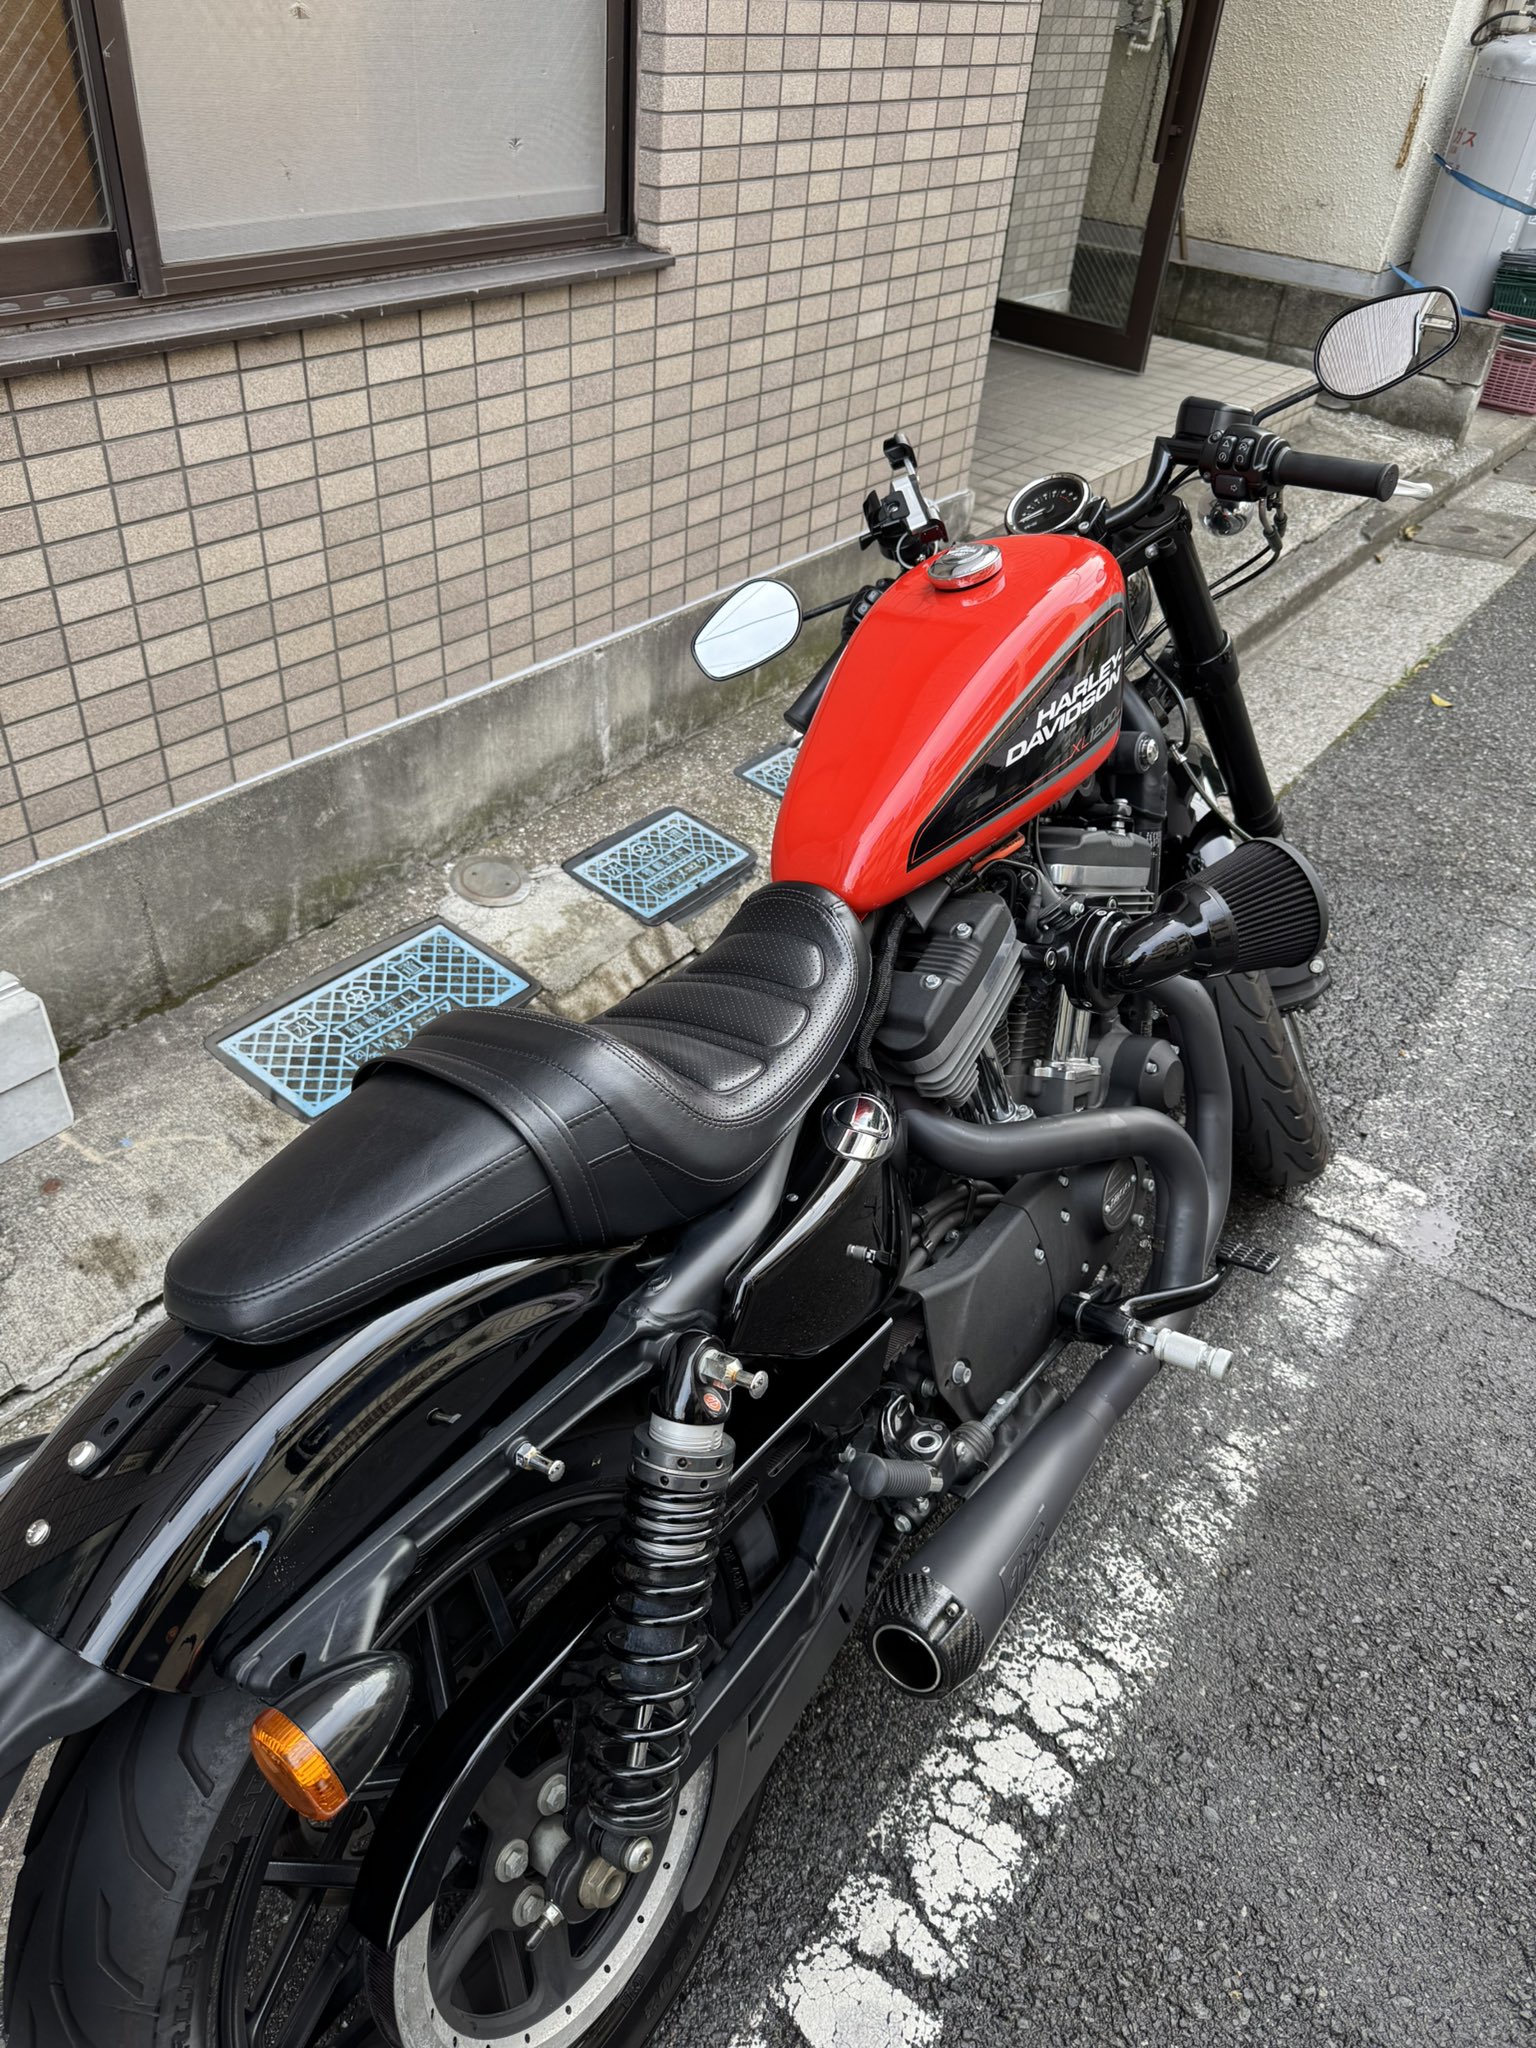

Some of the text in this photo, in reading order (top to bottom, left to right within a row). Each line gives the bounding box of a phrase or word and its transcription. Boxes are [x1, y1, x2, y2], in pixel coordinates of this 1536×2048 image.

[1005, 663, 1122, 768] DAVIDSON
[293, 959, 424, 1036] 水 道
